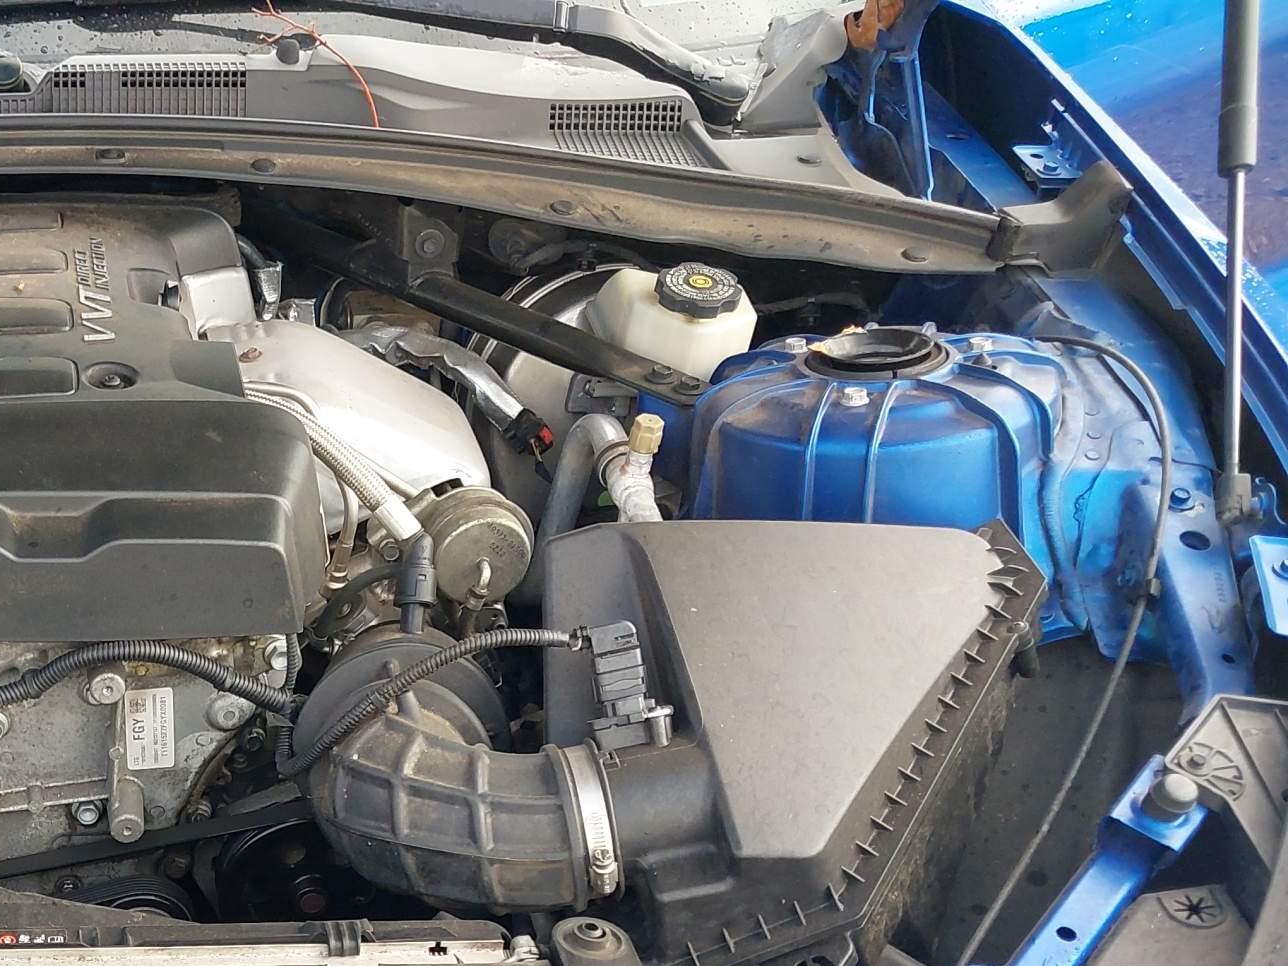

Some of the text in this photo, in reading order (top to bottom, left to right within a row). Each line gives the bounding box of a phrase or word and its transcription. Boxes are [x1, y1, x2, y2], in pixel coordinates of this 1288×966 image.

[73, 248, 91, 287] DIRECT
[90, 237, 111, 291] INJECTION
[78, 284, 116, 342] VVT
[133, 718, 145, 741] FGY
